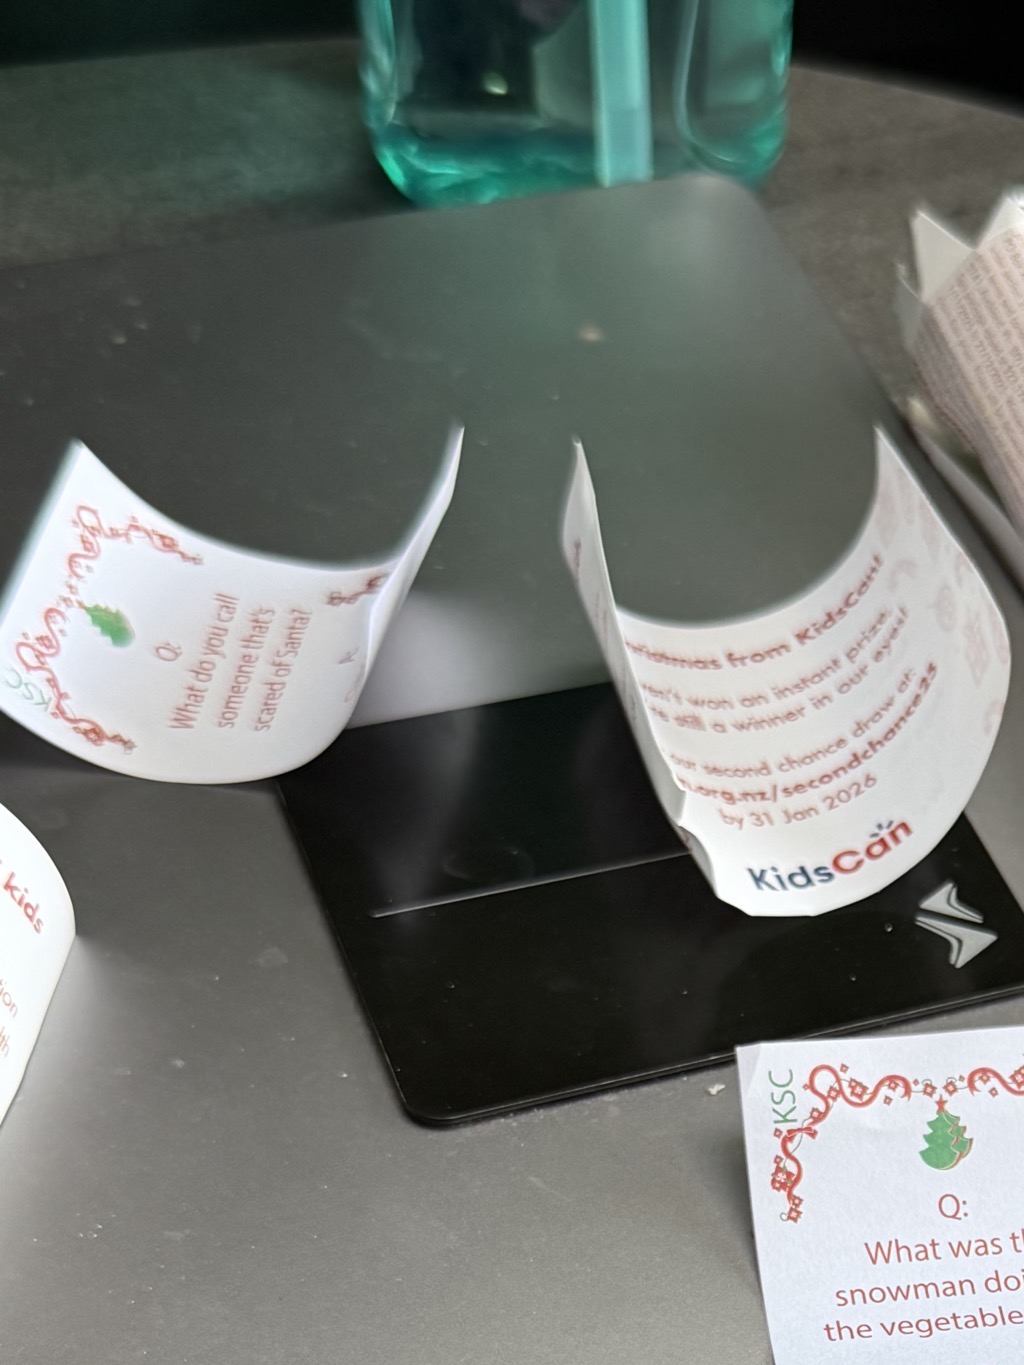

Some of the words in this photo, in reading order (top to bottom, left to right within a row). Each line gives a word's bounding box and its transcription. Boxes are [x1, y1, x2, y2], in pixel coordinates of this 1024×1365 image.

[214, 593, 239, 623] call
[203, 626, 228, 658] you
[276, 607, 312, 658] Santa?
[726, 642, 791, 667] from
[189, 660, 216, 683] do
[218, 654, 259, 728] someone
[241, 606, 275, 650] that's
[272, 659, 293, 678] of
[739, 694, 769, 708] an
[771, 657, 842, 700] instant
[168, 685, 208, 729] What
[255, 682, 286, 732] scared
[712, 723, 727, 733] a
[731, 706, 806, 732] winner
[809, 694, 833, 711] in
[836, 664, 868, 695] our
[703, 761, 772, 778] second
[778, 738, 848, 773] chance
[852, 695, 895, 737] draw
[718, 808, 744, 830] by
[750, 812, 774, 827] 31
[782, 805, 820, 824] Jan
[822, 773, 878, 811] 2026
[747, 820, 914, 891] KidsCan
[768, 1068, 798, 1125] KSC
[938, 1193, 969, 1220] Q:
[864, 1238, 941, 1266] What
[948, 1236, 1003, 1258] was
[835, 1278, 977, 1307] snowman
[823, 1318, 873, 1343] the
[879, 1305, 1024, 1340] vegetable
